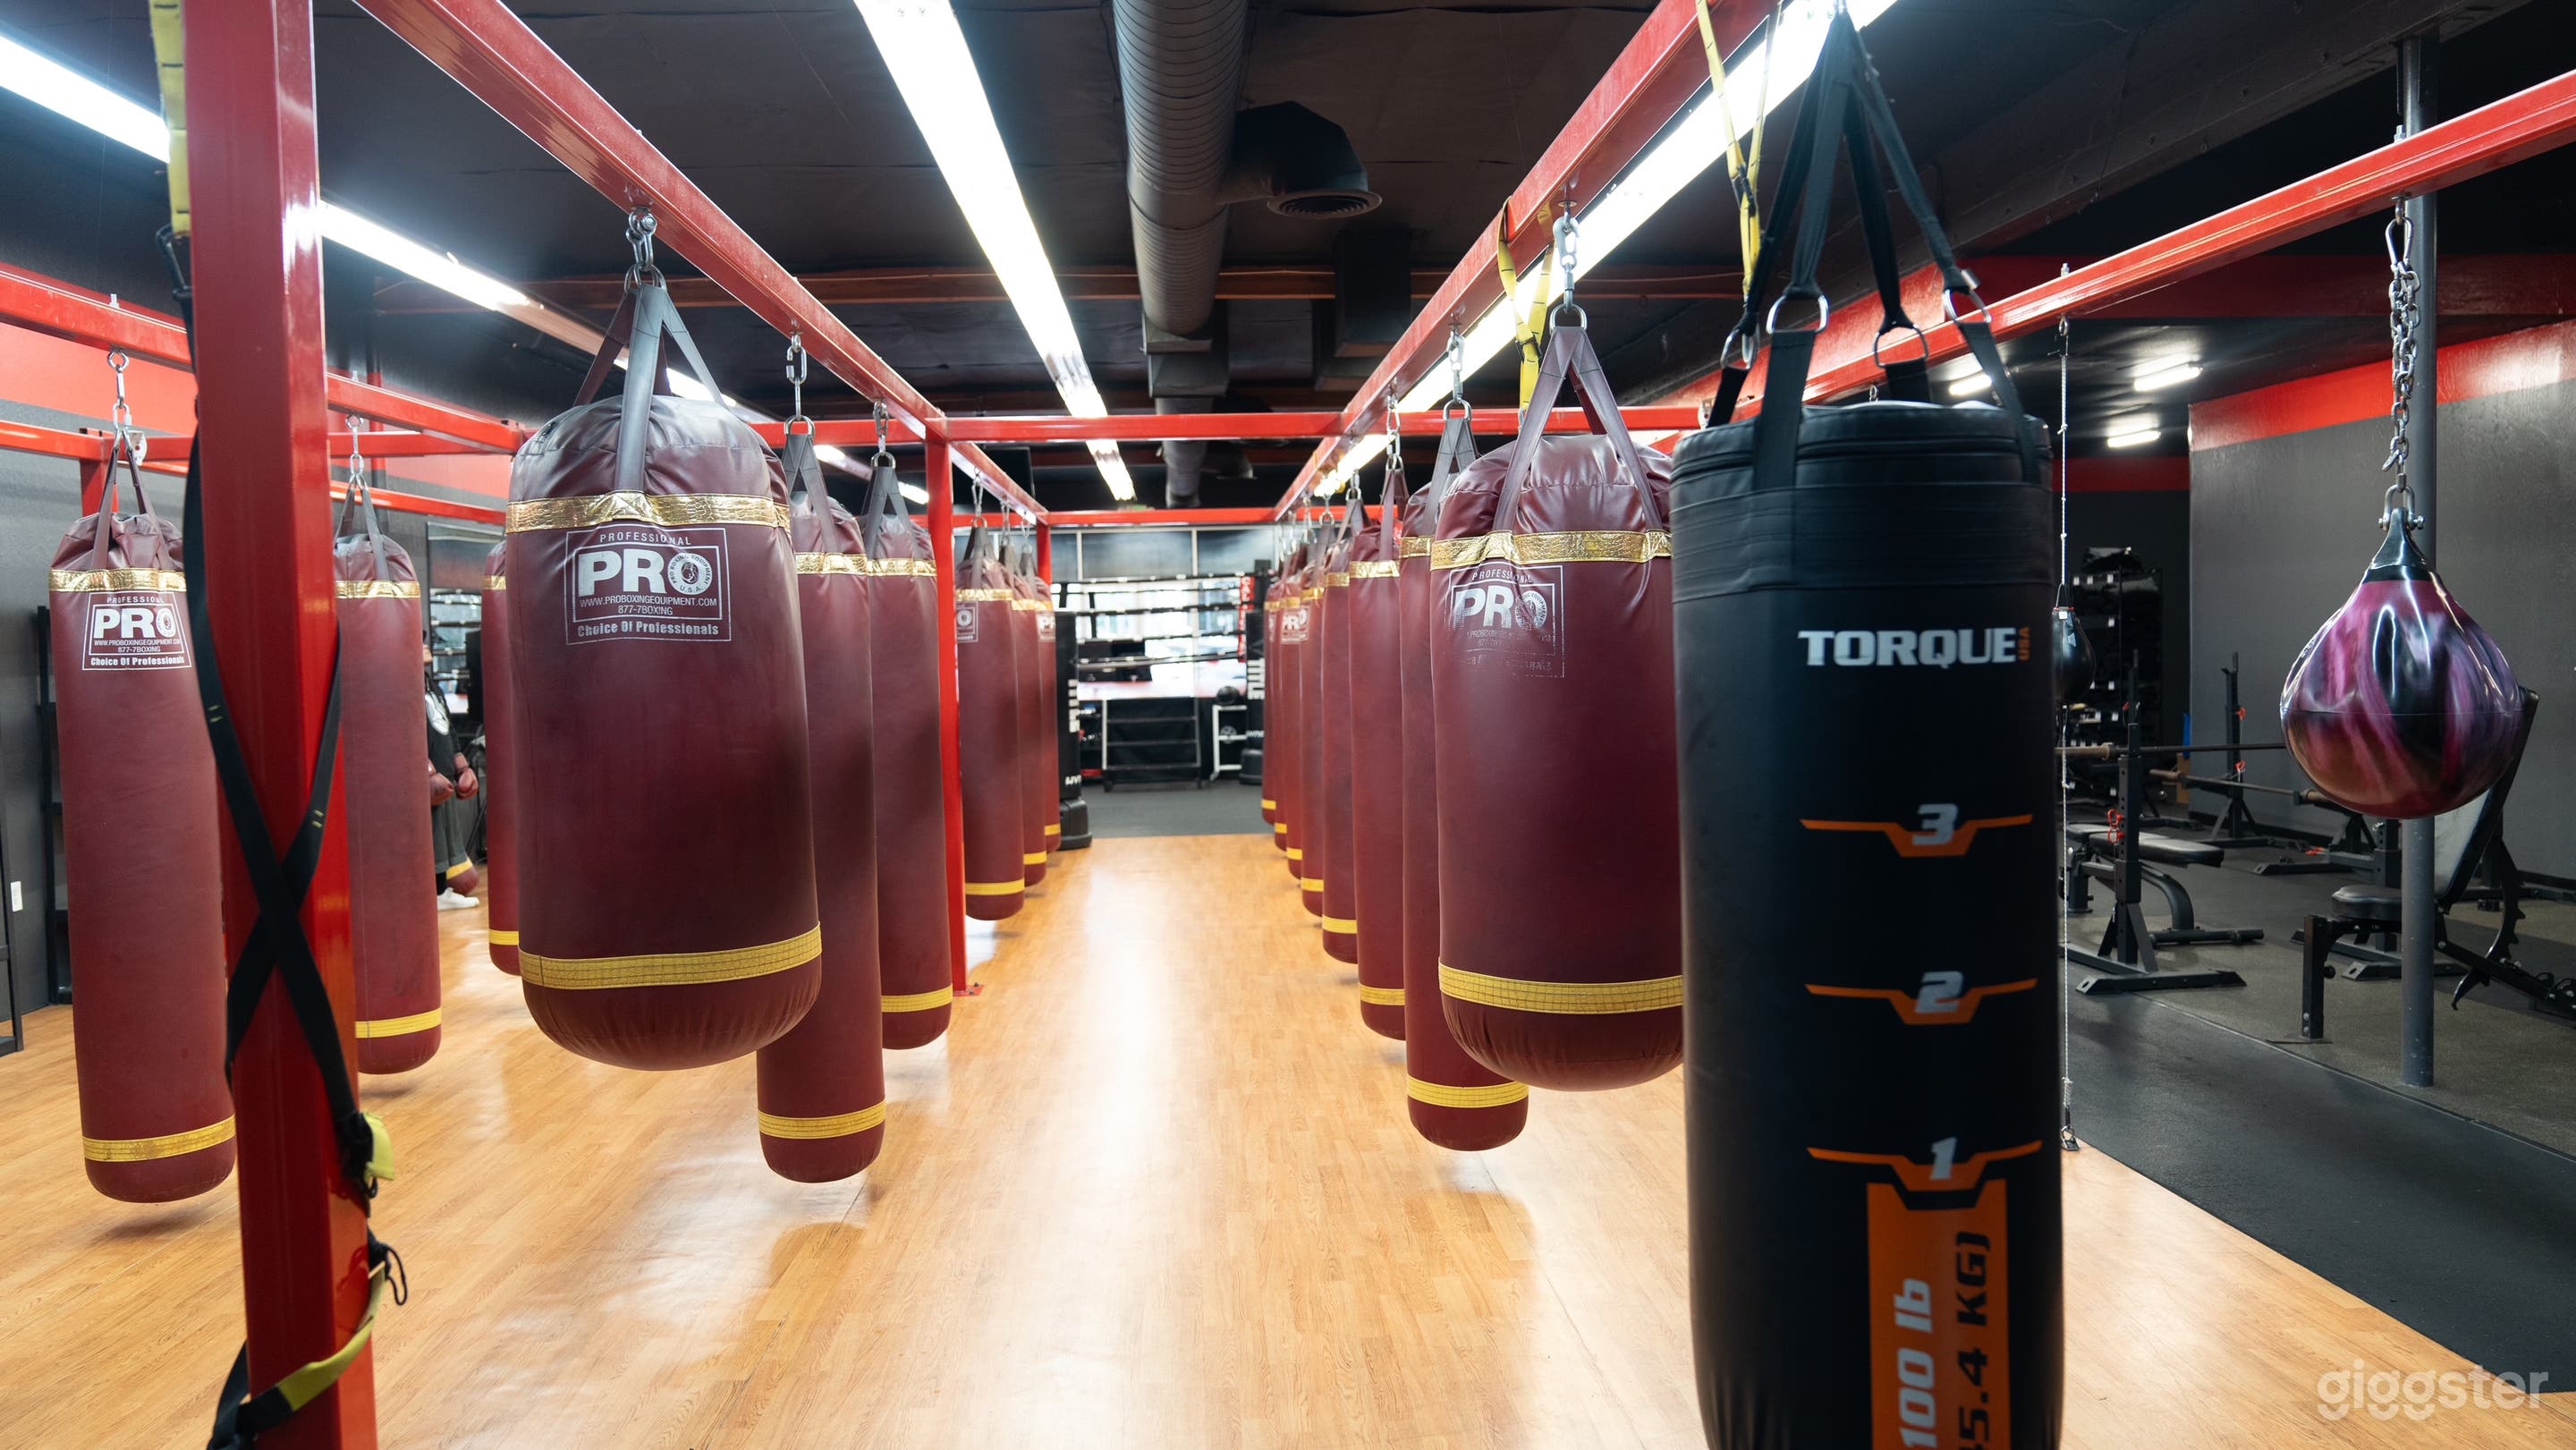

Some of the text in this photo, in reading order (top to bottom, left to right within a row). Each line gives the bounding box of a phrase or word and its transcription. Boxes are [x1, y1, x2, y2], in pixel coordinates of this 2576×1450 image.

[599, 531, 691, 546] PROFESSIONAL
[578, 548, 713, 597] PRO
[579, 595, 717, 607] WWW.PROBOXINGEQUIPMENT.COM
[618, 605, 674, 615] 877-7BOXING
[1453, 585, 1547, 631] PRO
[93, 607, 177, 639] PRO
[577, 621, 719, 637] Choice Of Professionals
[90, 657, 118, 666] Choice
[120, 657, 130, 666] Of
[1797, 627, 2016, 668] TORQUE
[2017, 627, 2031, 661] USA
[1911, 803, 1958, 845] 3
[1914, 971, 1963, 1014] 2
[1929, 1137, 1958, 1180] 1
[1956, 1231, 1991, 1450] 5.4 KG)
[1894, 1277, 1938, 1450] 100 lb
